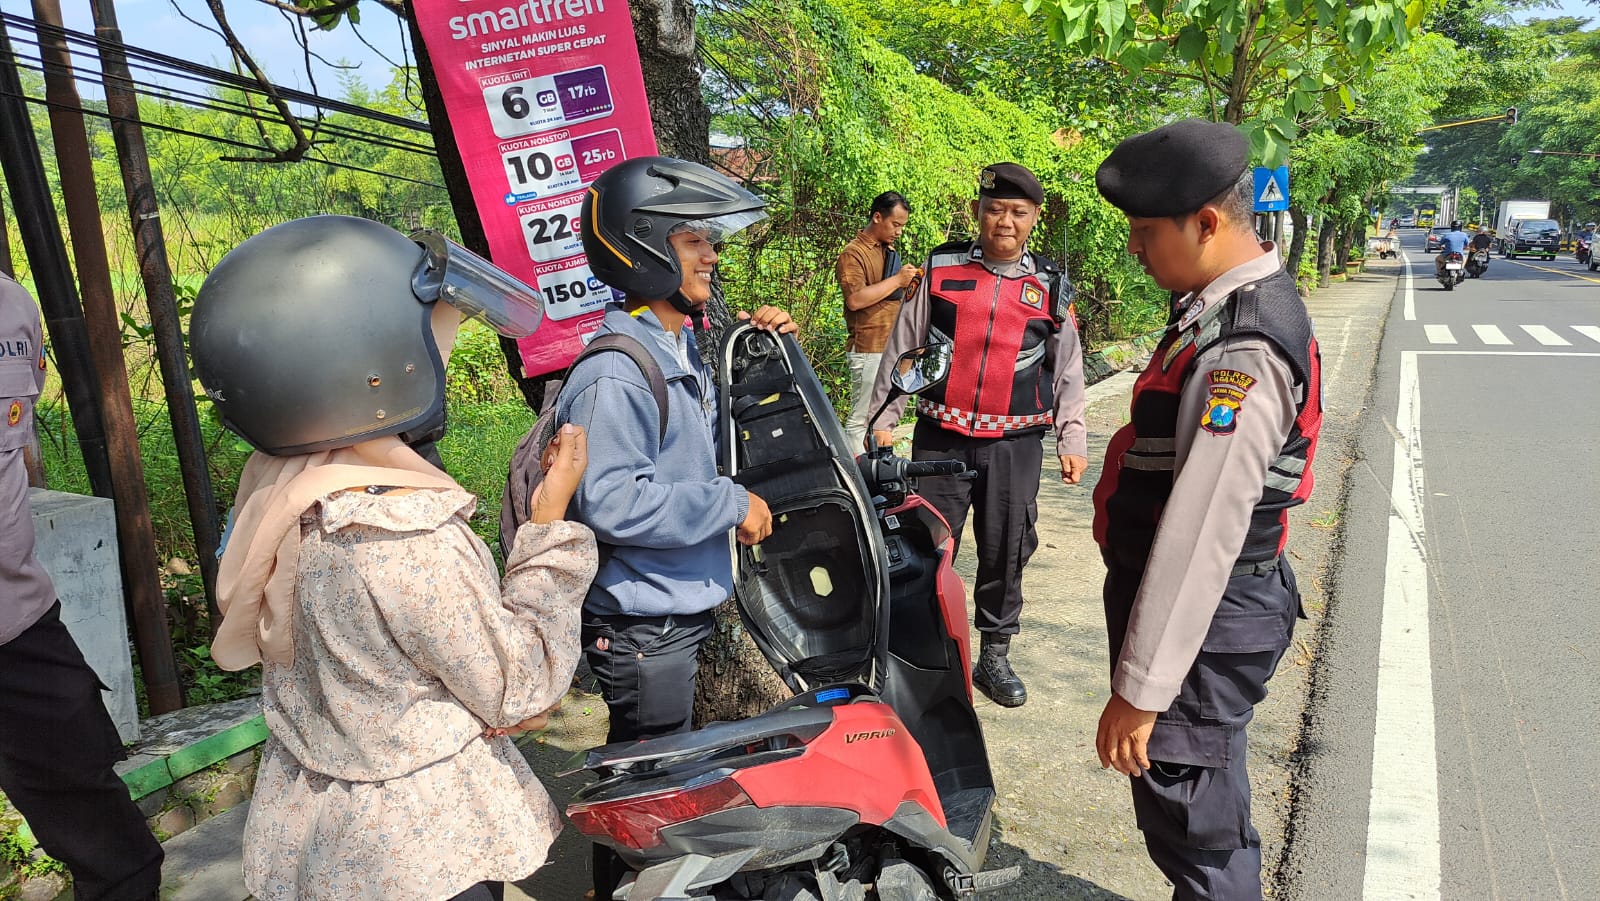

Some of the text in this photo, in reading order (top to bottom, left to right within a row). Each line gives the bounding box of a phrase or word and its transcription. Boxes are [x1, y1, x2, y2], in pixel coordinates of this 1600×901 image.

[449, 0, 605, 40] smartfren
[481, 24, 586, 54] SINYAL MAKIN LUAS
[465, 34, 607, 71] INTERNETAN SUPER CEPAT
[481, 70, 528, 87] KUOTA IRIT
[502, 86, 556, 120] 6 GB
[568, 84, 597, 100] 17rb
[500, 131, 568, 153] KUOTA NONSTOP
[582, 148, 615, 166] 25rb
[507, 152, 572, 185] 10 GB
[519, 194, 585, 215] KUOTA NONSTOP
[527, 214, 572, 245] 22
[536, 263, 563, 274] KUOTA
[542, 280, 587, 305] 150
[1213, 370, 1254, 383] POLRES
[845, 728, 896, 744] VARIO
